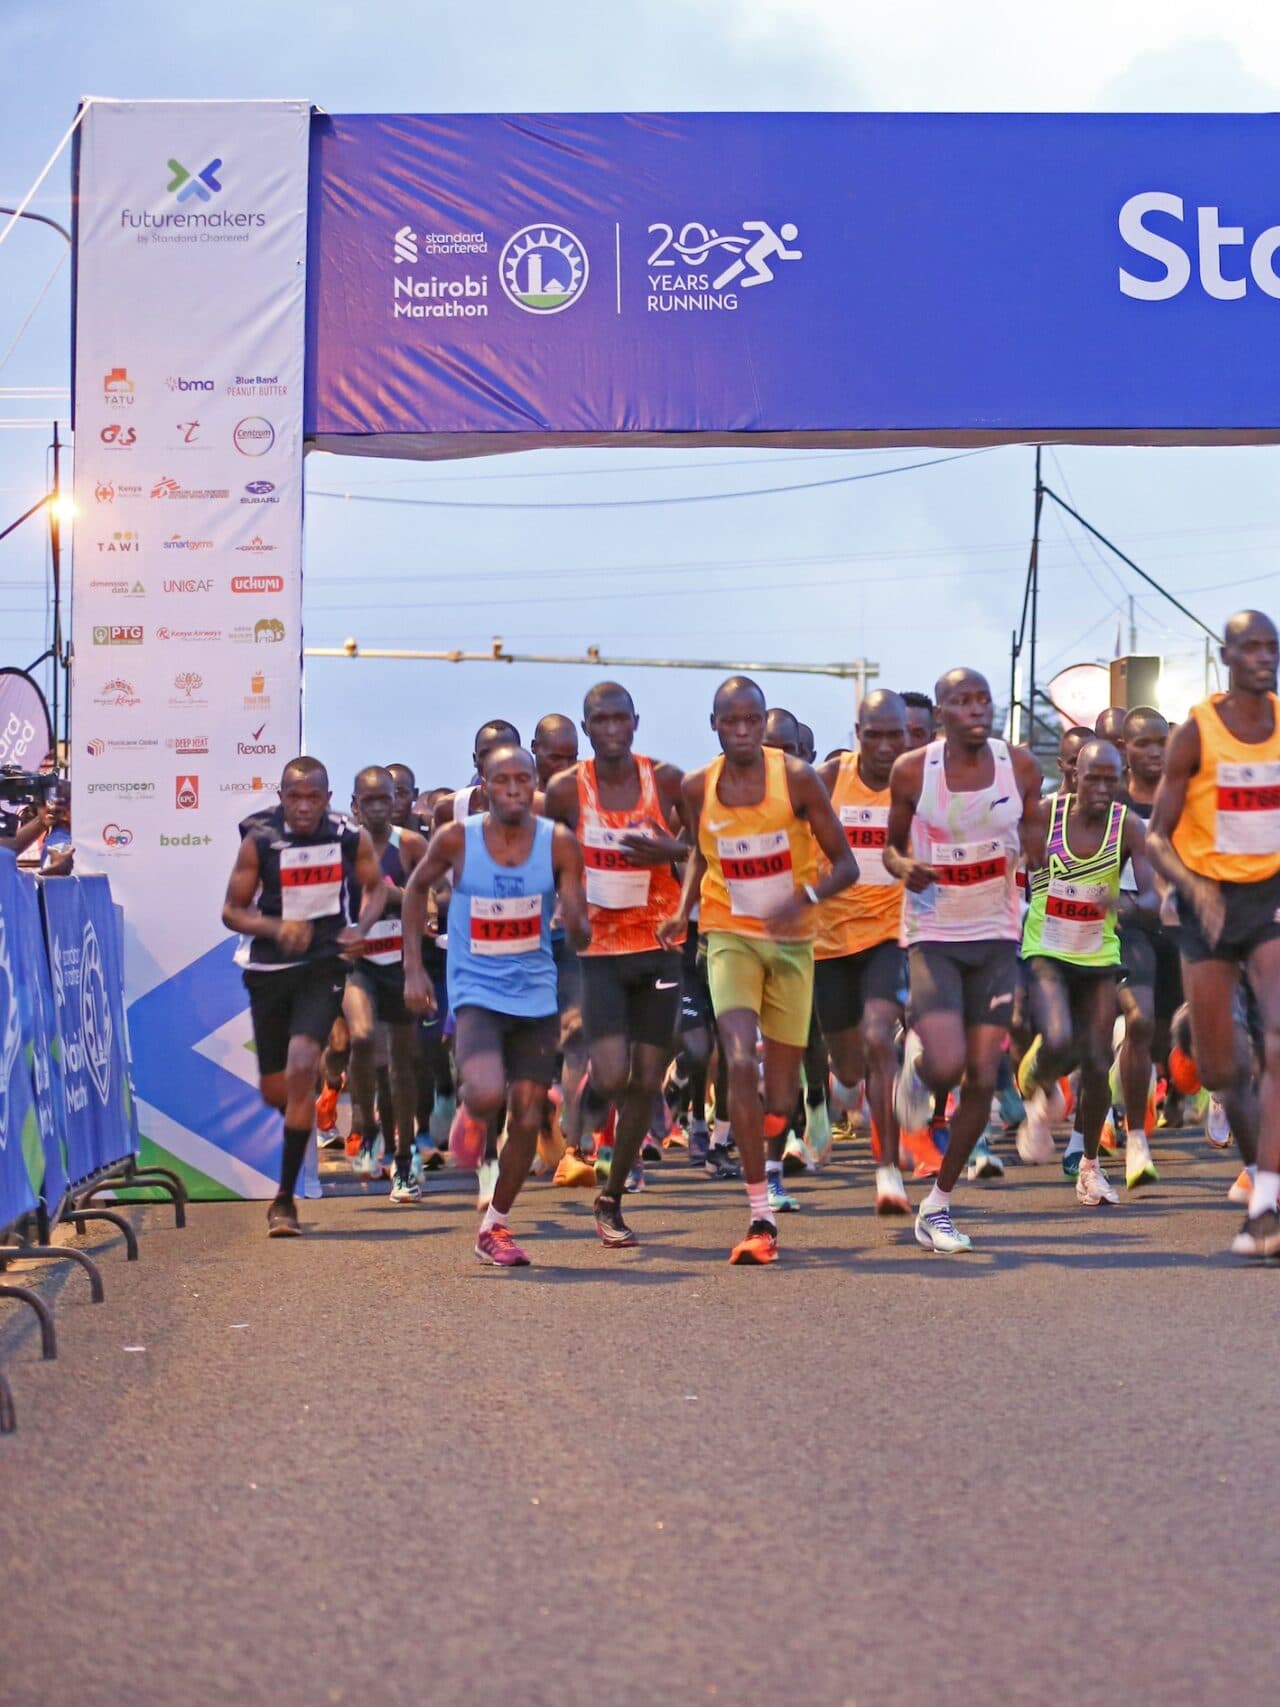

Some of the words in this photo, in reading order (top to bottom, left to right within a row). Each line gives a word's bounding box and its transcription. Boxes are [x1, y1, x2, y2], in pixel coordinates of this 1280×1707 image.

[121, 208, 266, 228] futuremakers
[152, 233, 198, 243] Standard
[200, 232, 249, 242] Chartered
[426, 231, 485, 244] standard
[647, 221, 712, 267] 20
[426, 242, 488, 255] chartered
[394, 275, 488, 299] Nairobi
[647, 275, 709, 292] YEARS
[394, 300, 488, 318] Marathon
[647, 294, 738, 311] RUNNING
[178, 377, 214, 391] bma
[235, 376, 255, 384] Blue
[256, 376, 278, 384] Band
[227, 386, 256, 396] PEANUT
[259, 385, 288, 396] BUTTER
[104, 396, 134, 404] TATU
[97, 542, 140, 552] TAWI
[163, 579, 214, 592] UNICAF
[235, 578, 280, 591] UCHUMI
[112, 627, 141, 639] PTG
[237, 742, 276, 755] Rexona
[87, 782, 155, 794] greenspoon
[848, 830, 886, 845] 183
[291, 868, 334, 883] 1717
[944, 863, 997, 883] 1534
[481, 920, 533, 938] 1733
